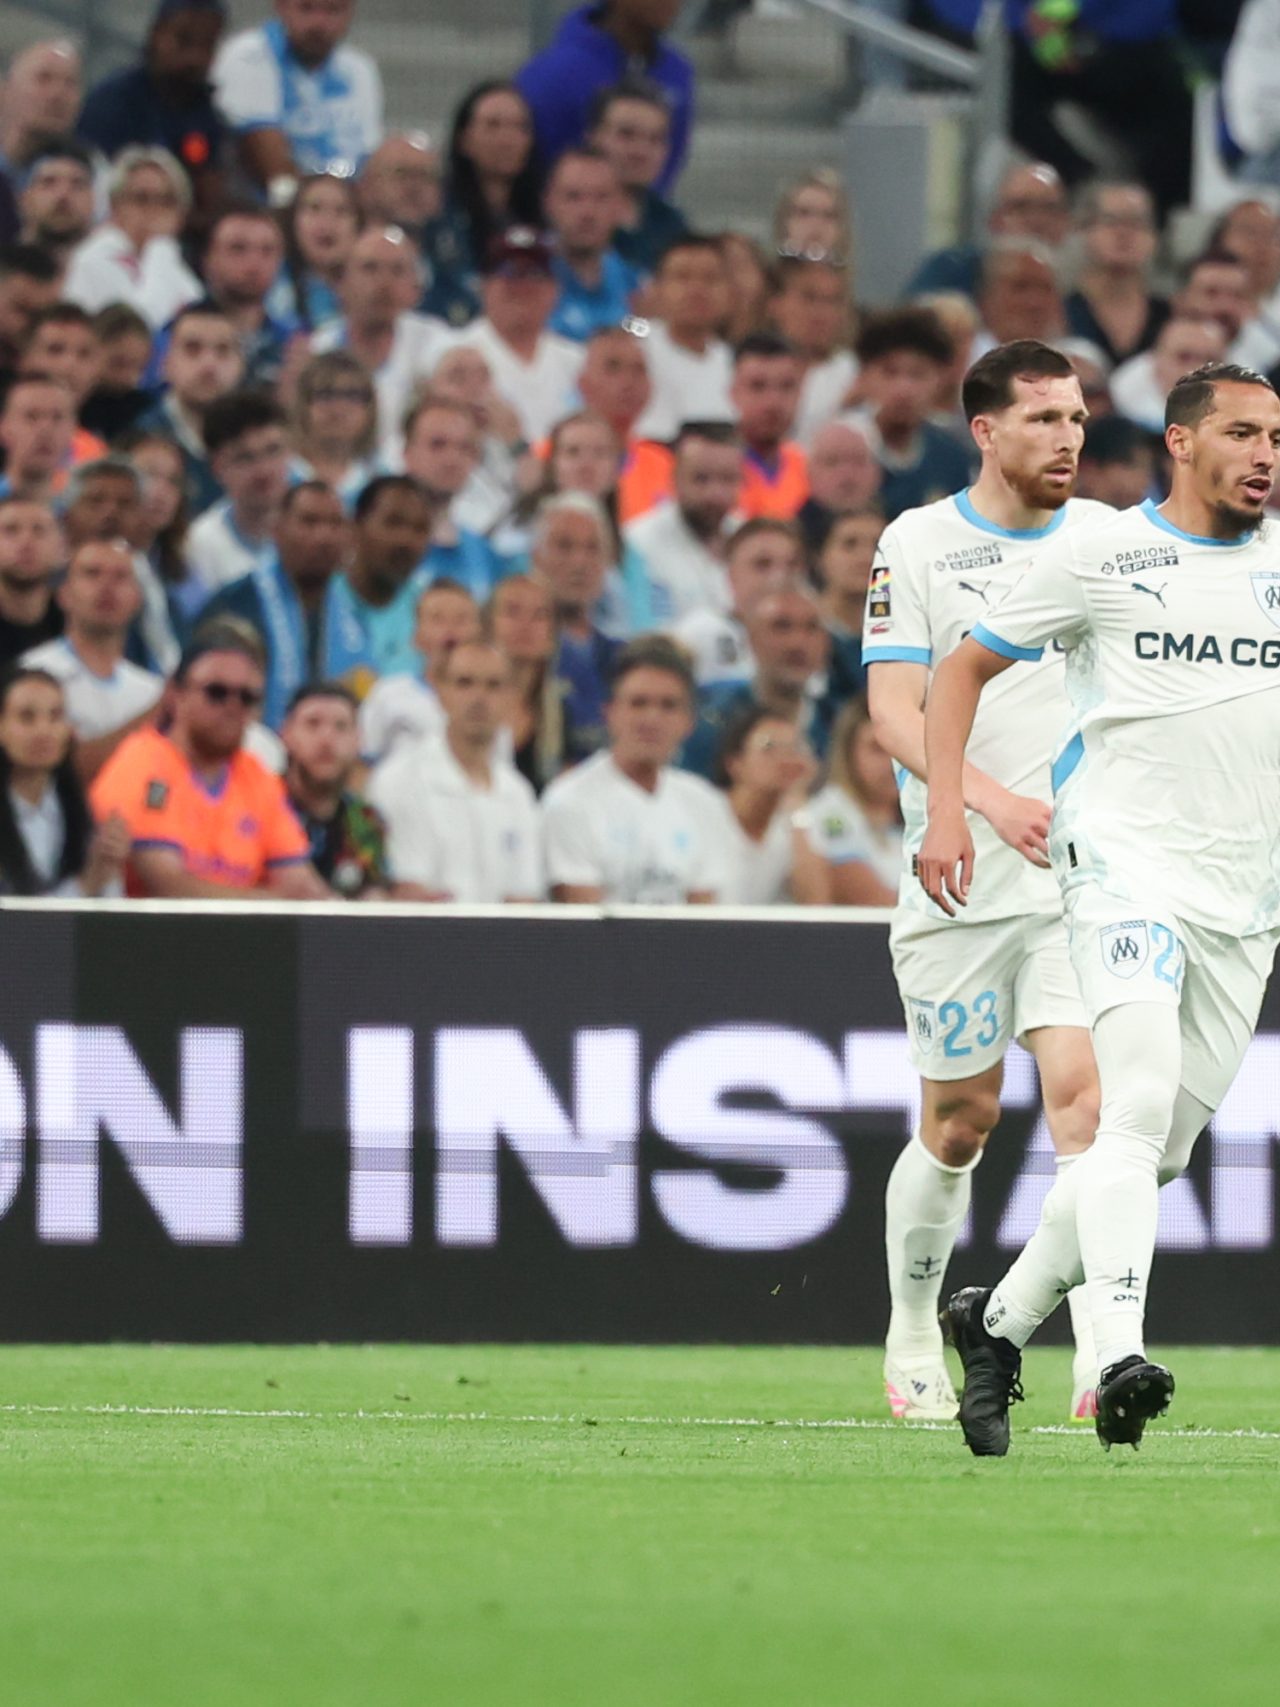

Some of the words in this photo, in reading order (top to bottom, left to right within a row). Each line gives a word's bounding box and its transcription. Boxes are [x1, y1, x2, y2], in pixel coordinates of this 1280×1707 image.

[944, 541, 1000, 561] PARIONS
[1116, 545, 1177, 564] PARIONS
[1120, 556, 1178, 574] SPORT
[1135, 631, 1223, 664] CMA
[1150, 922, 1183, 993] 2
[938, 990, 998, 1057] 23
[0, 1024, 243, 1245] N
